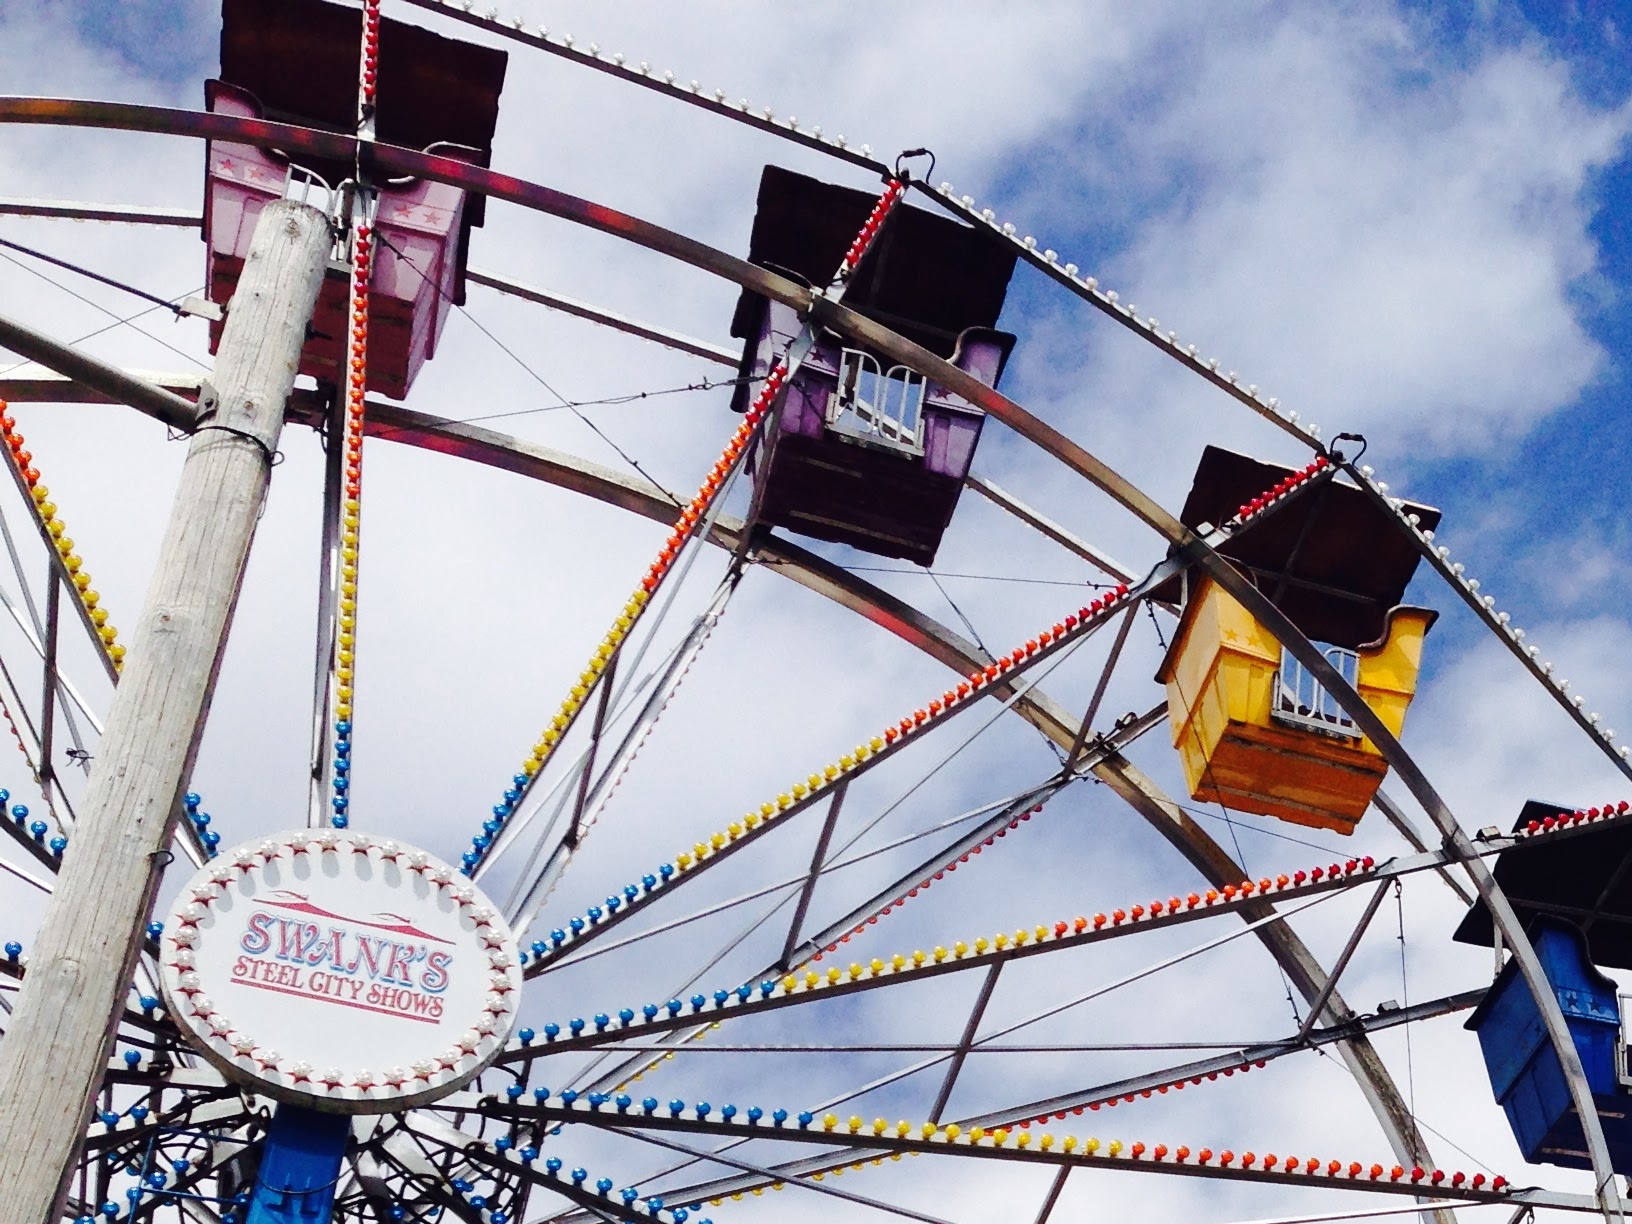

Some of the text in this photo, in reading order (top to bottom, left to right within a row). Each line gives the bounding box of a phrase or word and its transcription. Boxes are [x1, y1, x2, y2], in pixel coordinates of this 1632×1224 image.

[232, 955, 444, 1018] STEEL CITY SHOWS
[240, 910, 453, 993] SWANK'S
